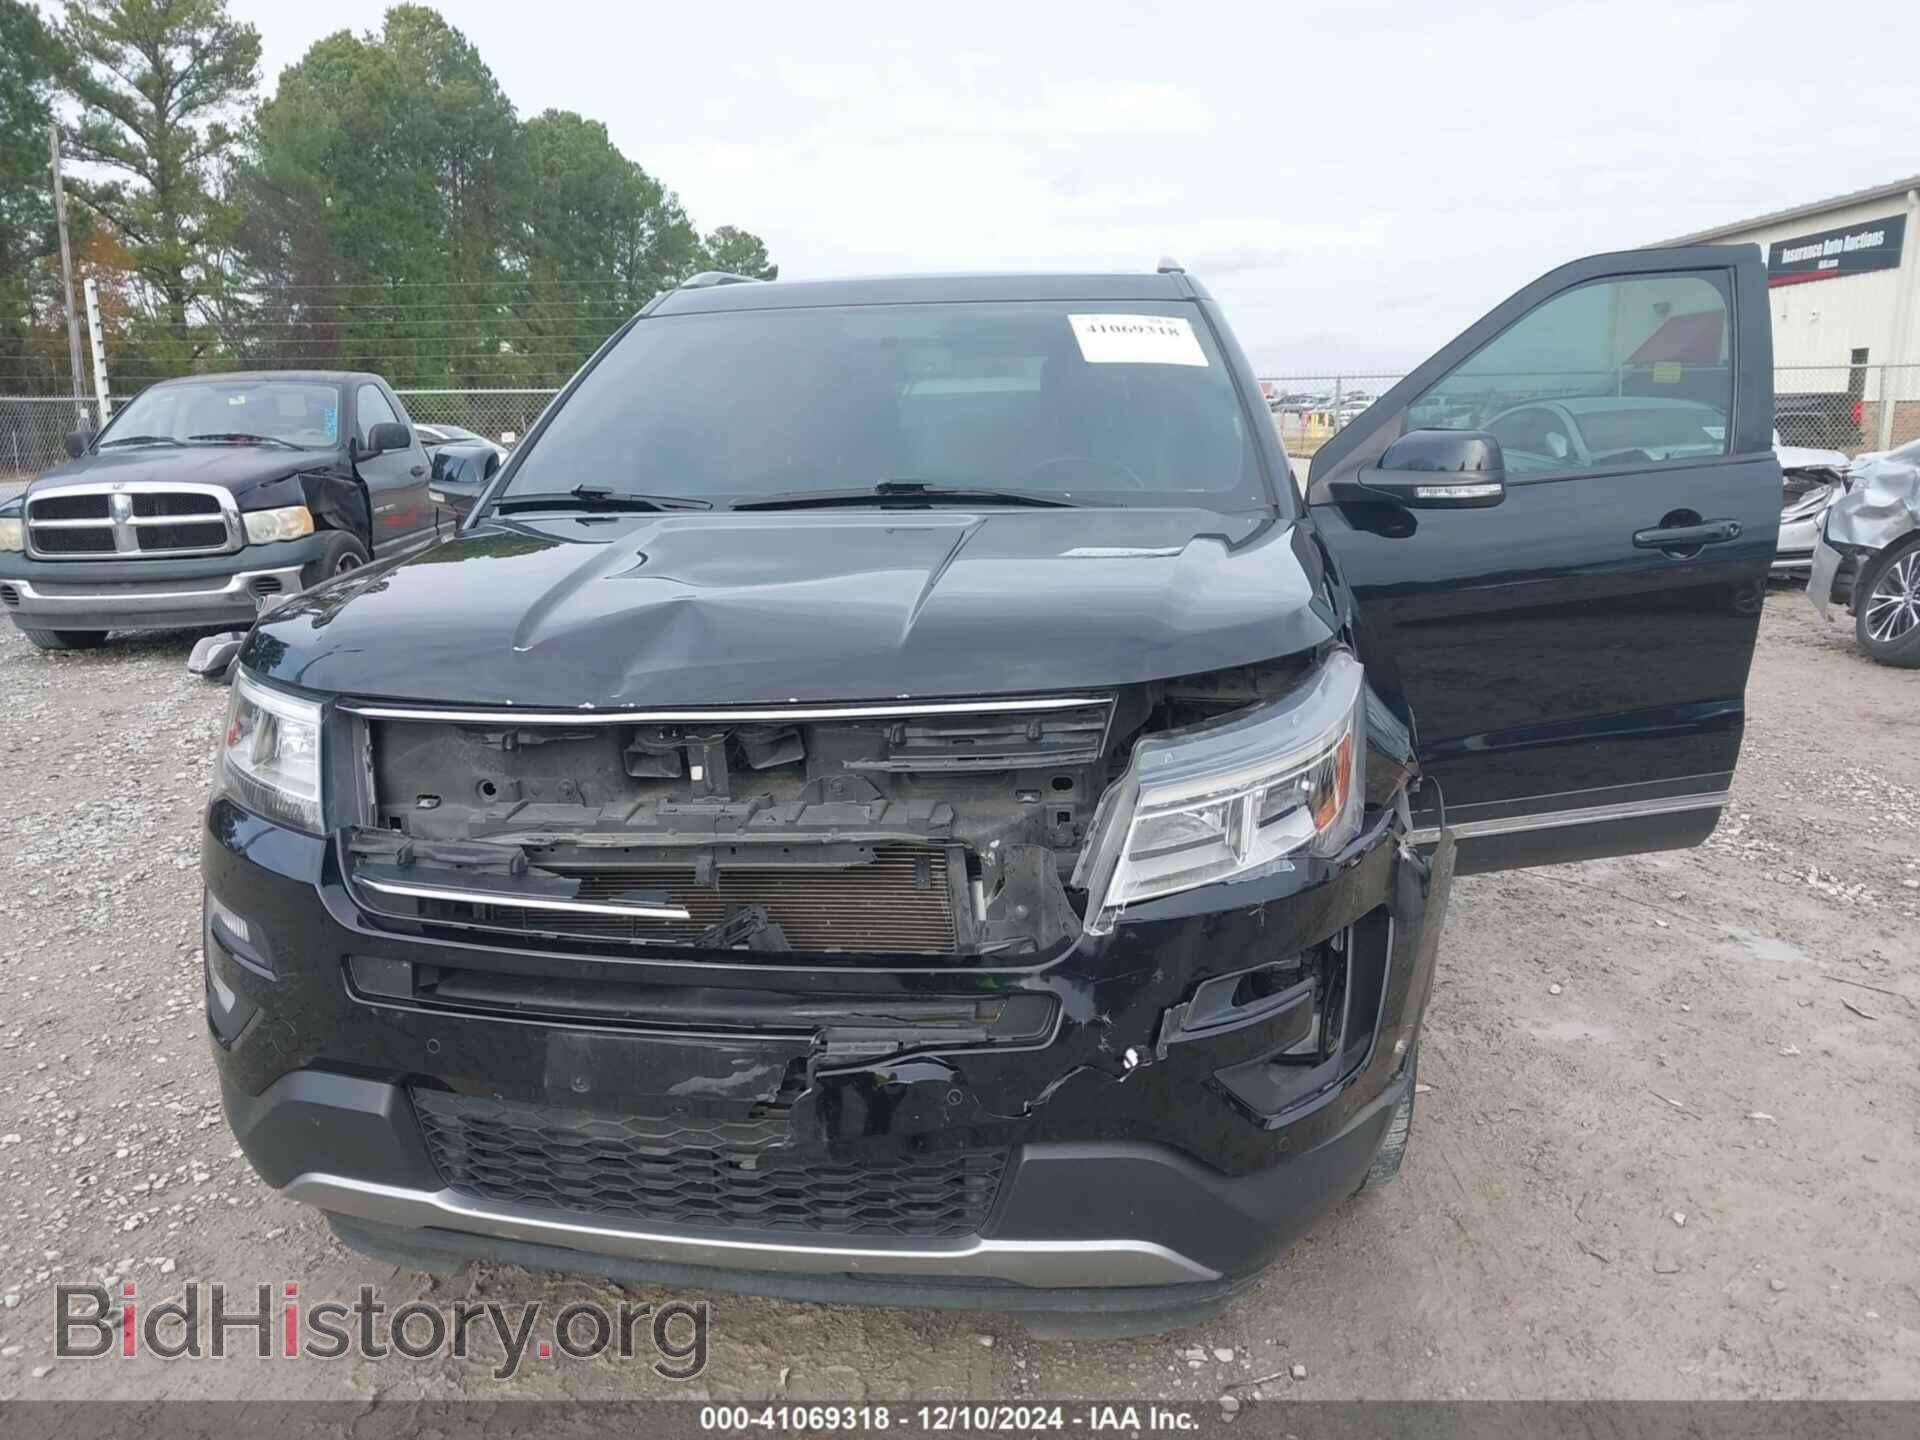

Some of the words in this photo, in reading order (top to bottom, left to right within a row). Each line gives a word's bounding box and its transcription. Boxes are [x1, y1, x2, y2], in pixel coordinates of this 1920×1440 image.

[1781, 243, 1823, 264] Insurance
[1823, 239, 1843, 256] Auto
[1843, 230, 1885, 252] Auctions
[1086, 323, 1180, 337] 41069318
